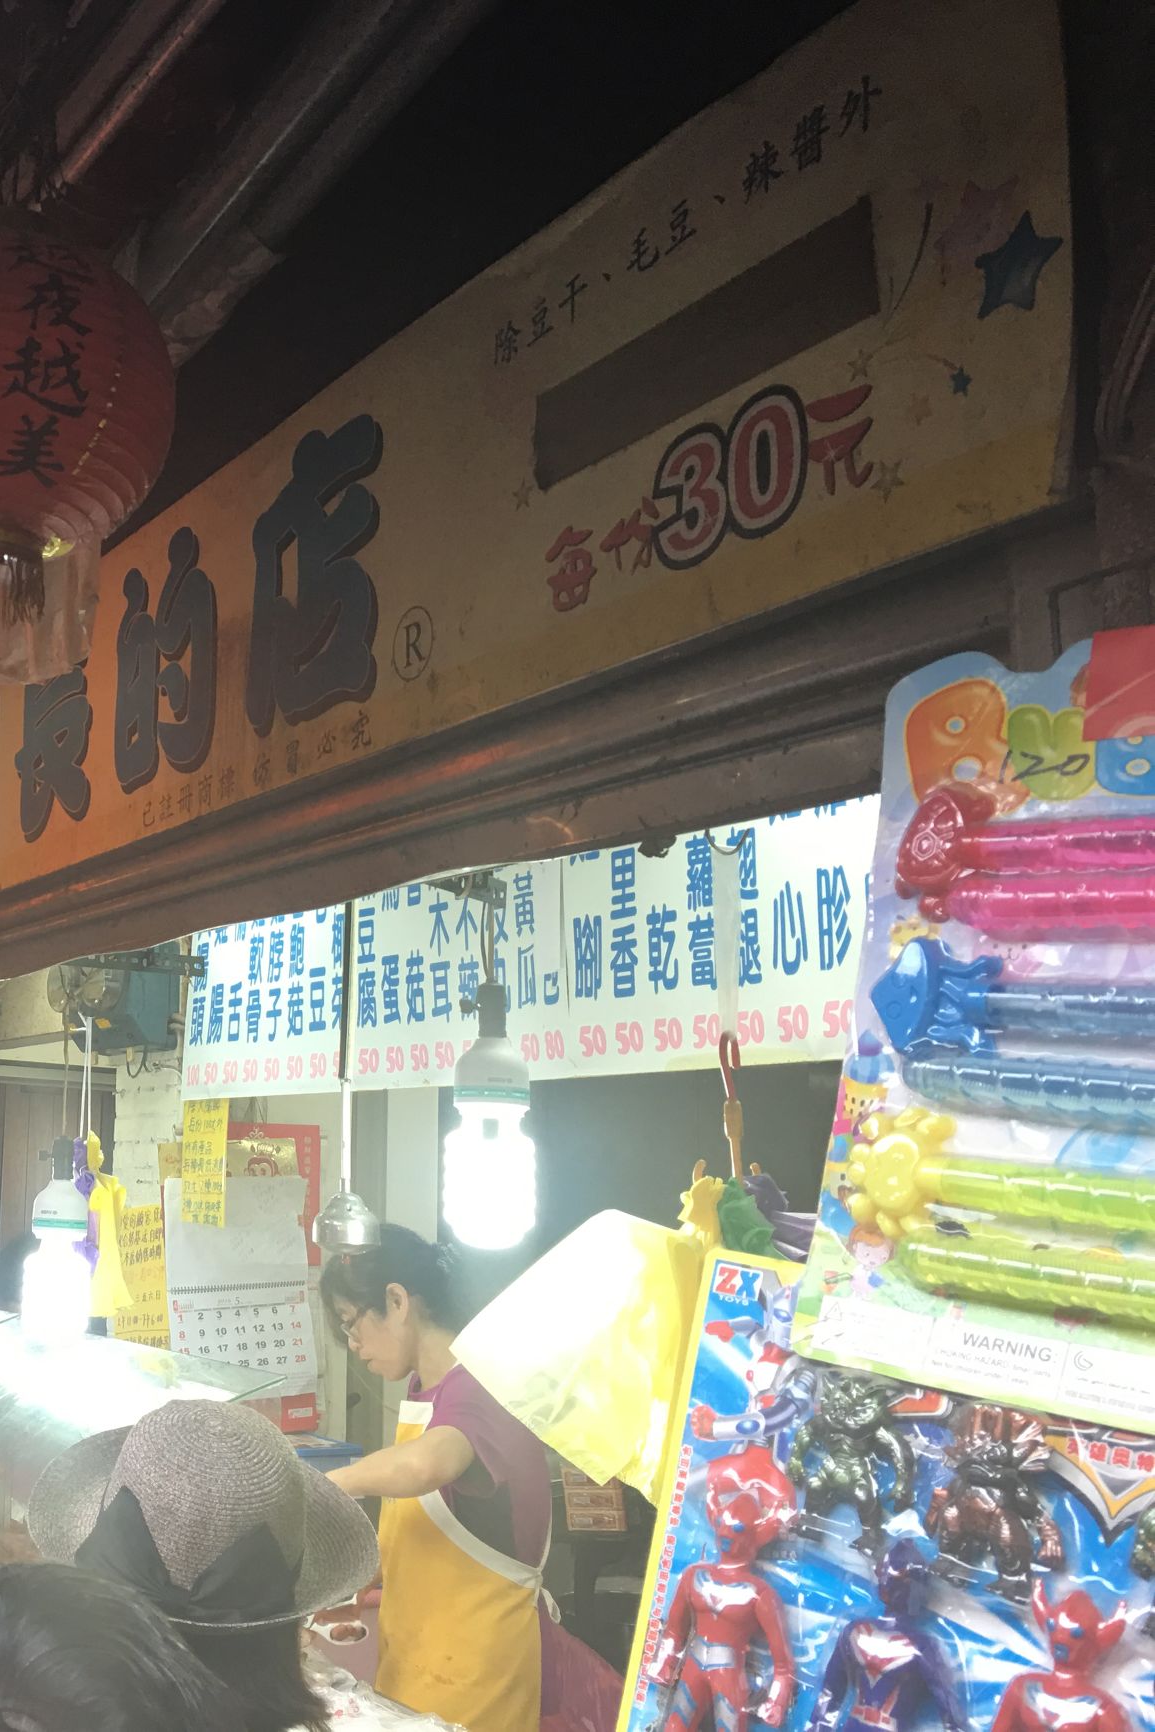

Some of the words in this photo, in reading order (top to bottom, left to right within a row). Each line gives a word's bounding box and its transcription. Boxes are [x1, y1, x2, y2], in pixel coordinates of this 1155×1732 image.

[287, 911, 306, 1039] 鮑菇
[357, 894, 378, 1029] 豆腐
[189, 931, 211, 1047] 腸頭
[246, 918, 266, 1045] 軟骨
[579, 1024, 607, 1058] 50
[615, 1021, 644, 1055] 50
[654, 1018, 683, 1052] 50
[693, 1014, 719, 1048] 50
[737, 1010, 765, 1046] 50
[777, 1004, 809, 1042] 50
[822, 999, 854, 1039] 50
[358, 1048, 379, 1075] 50
[386, 1046, 404, 1073] 50
[410, 1043, 429, 1072] 50
[435, 1041, 455, 1070] 50
[520, 1033, 540, 1062] 50
[544, 1029, 565, 1060] 80
[204, 1062, 219, 1084] 50
[222, 1060, 239, 1085] 50
[242, 1059, 259, 1083] 50
[264, 1058, 280, 1082] 50
[286, 1055, 303, 1080] 50
[309, 1053, 327, 1079] 50
[715, 1266, 761, 1299] ZX
[197, 1312, 204, 1320] 2
[234, 1309, 241, 1317] 4
[253, 1308, 259, 1316] 5
[271, 1306, 278, 1314] 6
[718, 1295, 750, 1306] TOYS
[199, 1329, 205, 1337] 9
[216, 1328, 227, 1336] 10
[235, 1326, 246, 1334] 11
[252, 1324, 265, 1333] 12
[271, 1323, 283, 1331] 13
[198, 1346, 210, 1354] 16
[217, 1344, 228, 1352] 17
[236, 1342, 248, 1351] 18
[255, 1341, 267, 1349] 19
[273, 1339, 285, 1348] 20
[256, 1358, 269, 1366] 26
[276, 1356, 288, 1364] 27
[962, 1332, 1058, 1363] WARNING:
